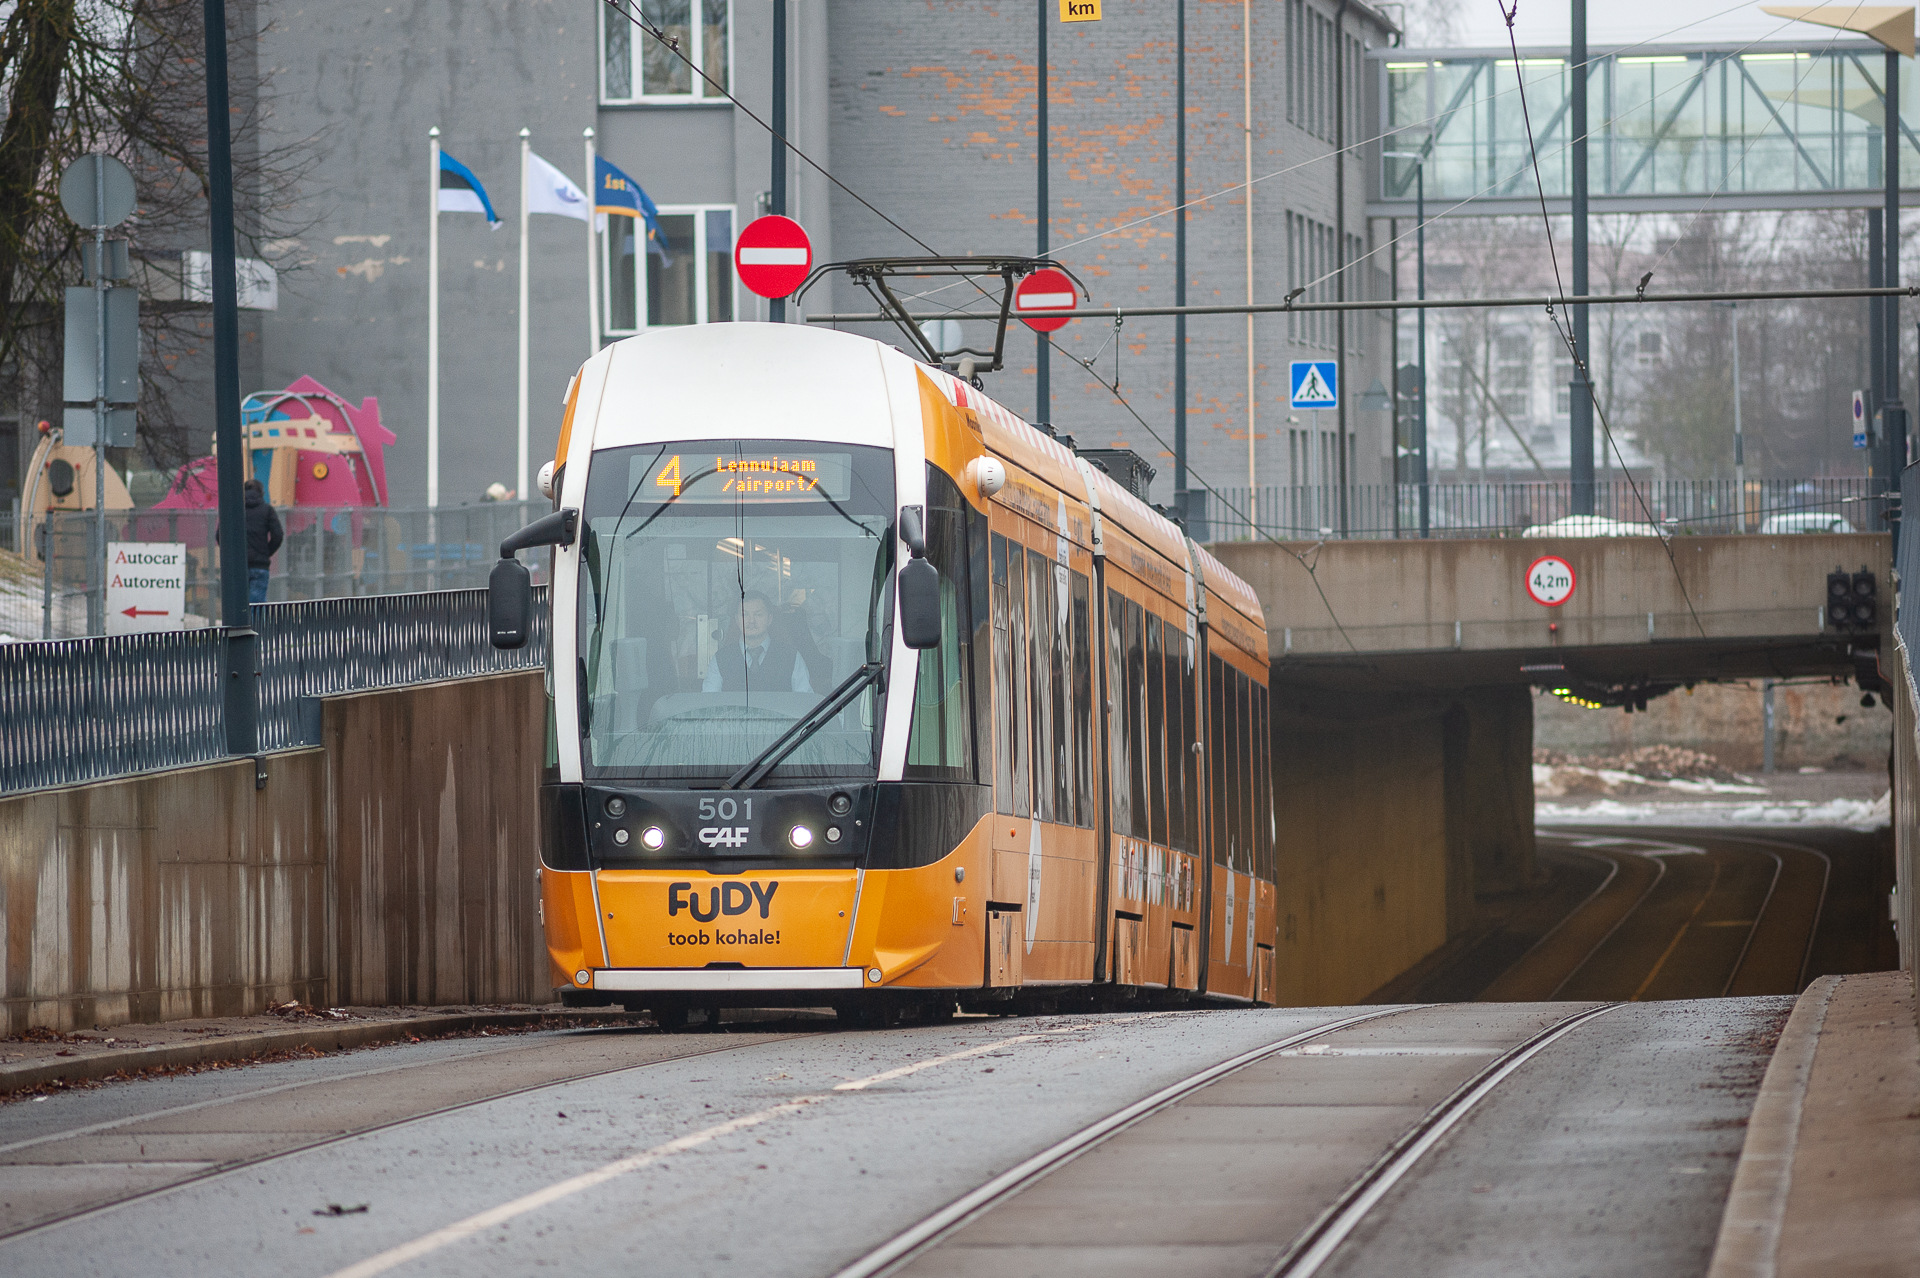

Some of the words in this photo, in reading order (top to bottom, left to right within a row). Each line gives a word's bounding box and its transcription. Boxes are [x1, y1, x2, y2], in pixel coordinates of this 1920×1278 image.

[1068, 1, 1095, 16] km
[716, 456, 817, 474] Lennujaam
[656, 455, 682, 496] 4
[722, 476, 820, 493] /airport/
[115, 550, 178, 565] Autocar
[111, 574, 182, 589] Autorent
[698, 797, 752, 821] 501
[698, 827, 750, 848] CAF
[668, 880, 779, 923] FUDY
[667, 929, 711, 946] toob
[715, 928, 781, 945] kohale!
